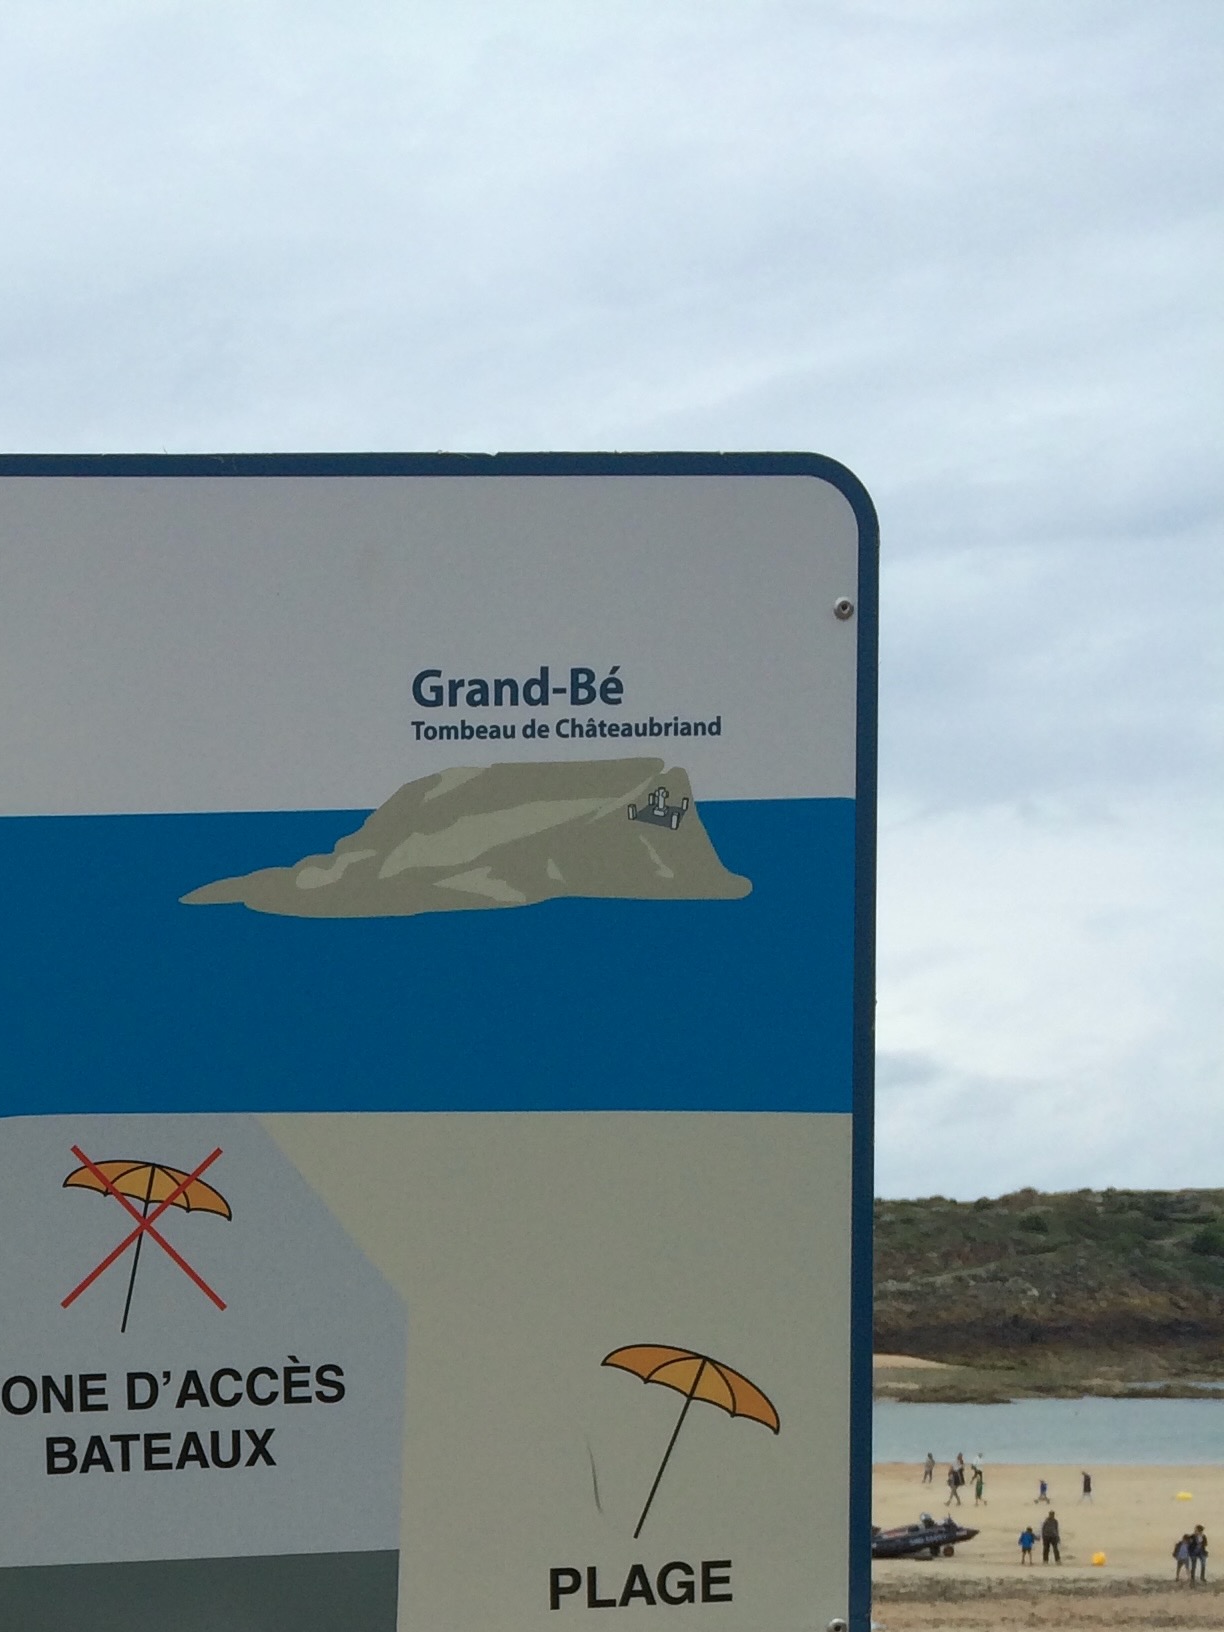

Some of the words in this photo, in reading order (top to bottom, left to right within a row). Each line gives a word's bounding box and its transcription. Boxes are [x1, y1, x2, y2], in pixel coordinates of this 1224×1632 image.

[411, 665, 625, 708] Grand-Bé
[411, 720, 516, 741] Tombeau
[522, 718, 550, 740] de
[555, 715, 722, 739] Châteaubriand
[126, 1355, 346, 1411] D'ACCÈS
[45, 1428, 277, 1475] BATEAUX
[549, 1559, 733, 1611] PLAGE
